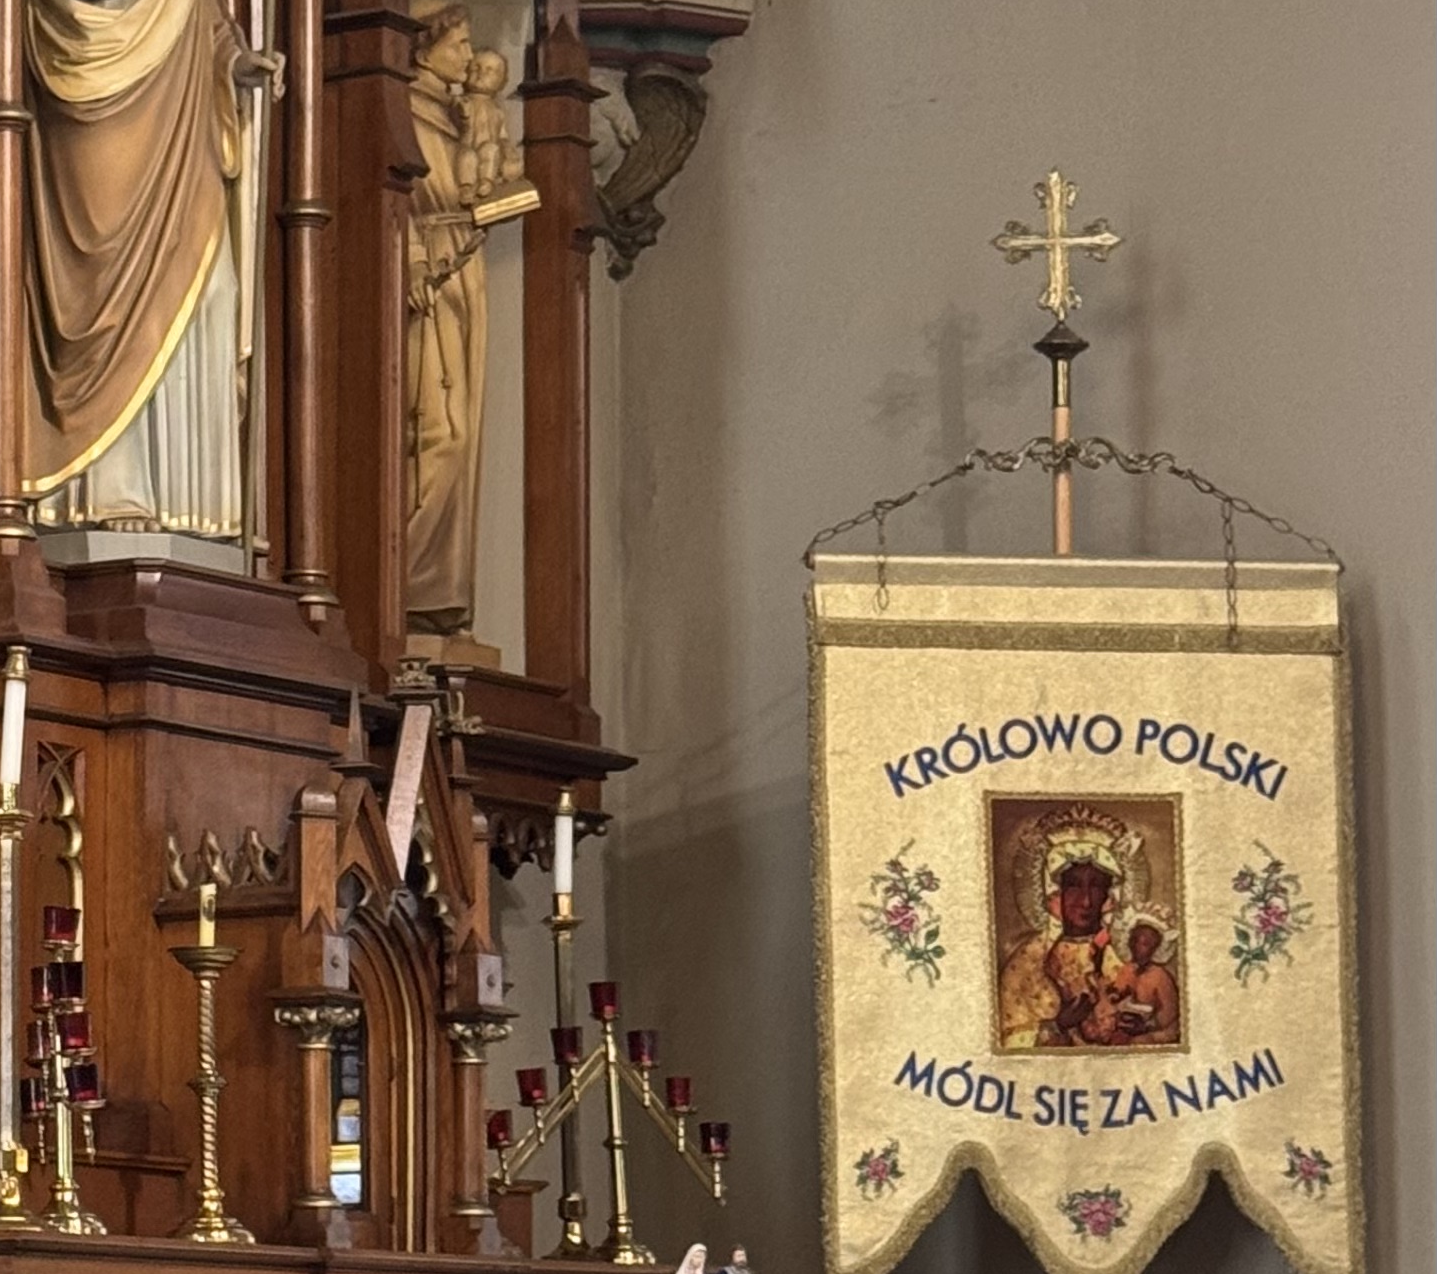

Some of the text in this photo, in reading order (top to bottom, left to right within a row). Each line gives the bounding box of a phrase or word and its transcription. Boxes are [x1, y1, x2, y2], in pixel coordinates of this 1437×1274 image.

[884, 713, 1289, 801] KRÓLOWO POLSKI
[894, 1048, 1285, 1135] MÓDL SIĘ ZA NAMI
